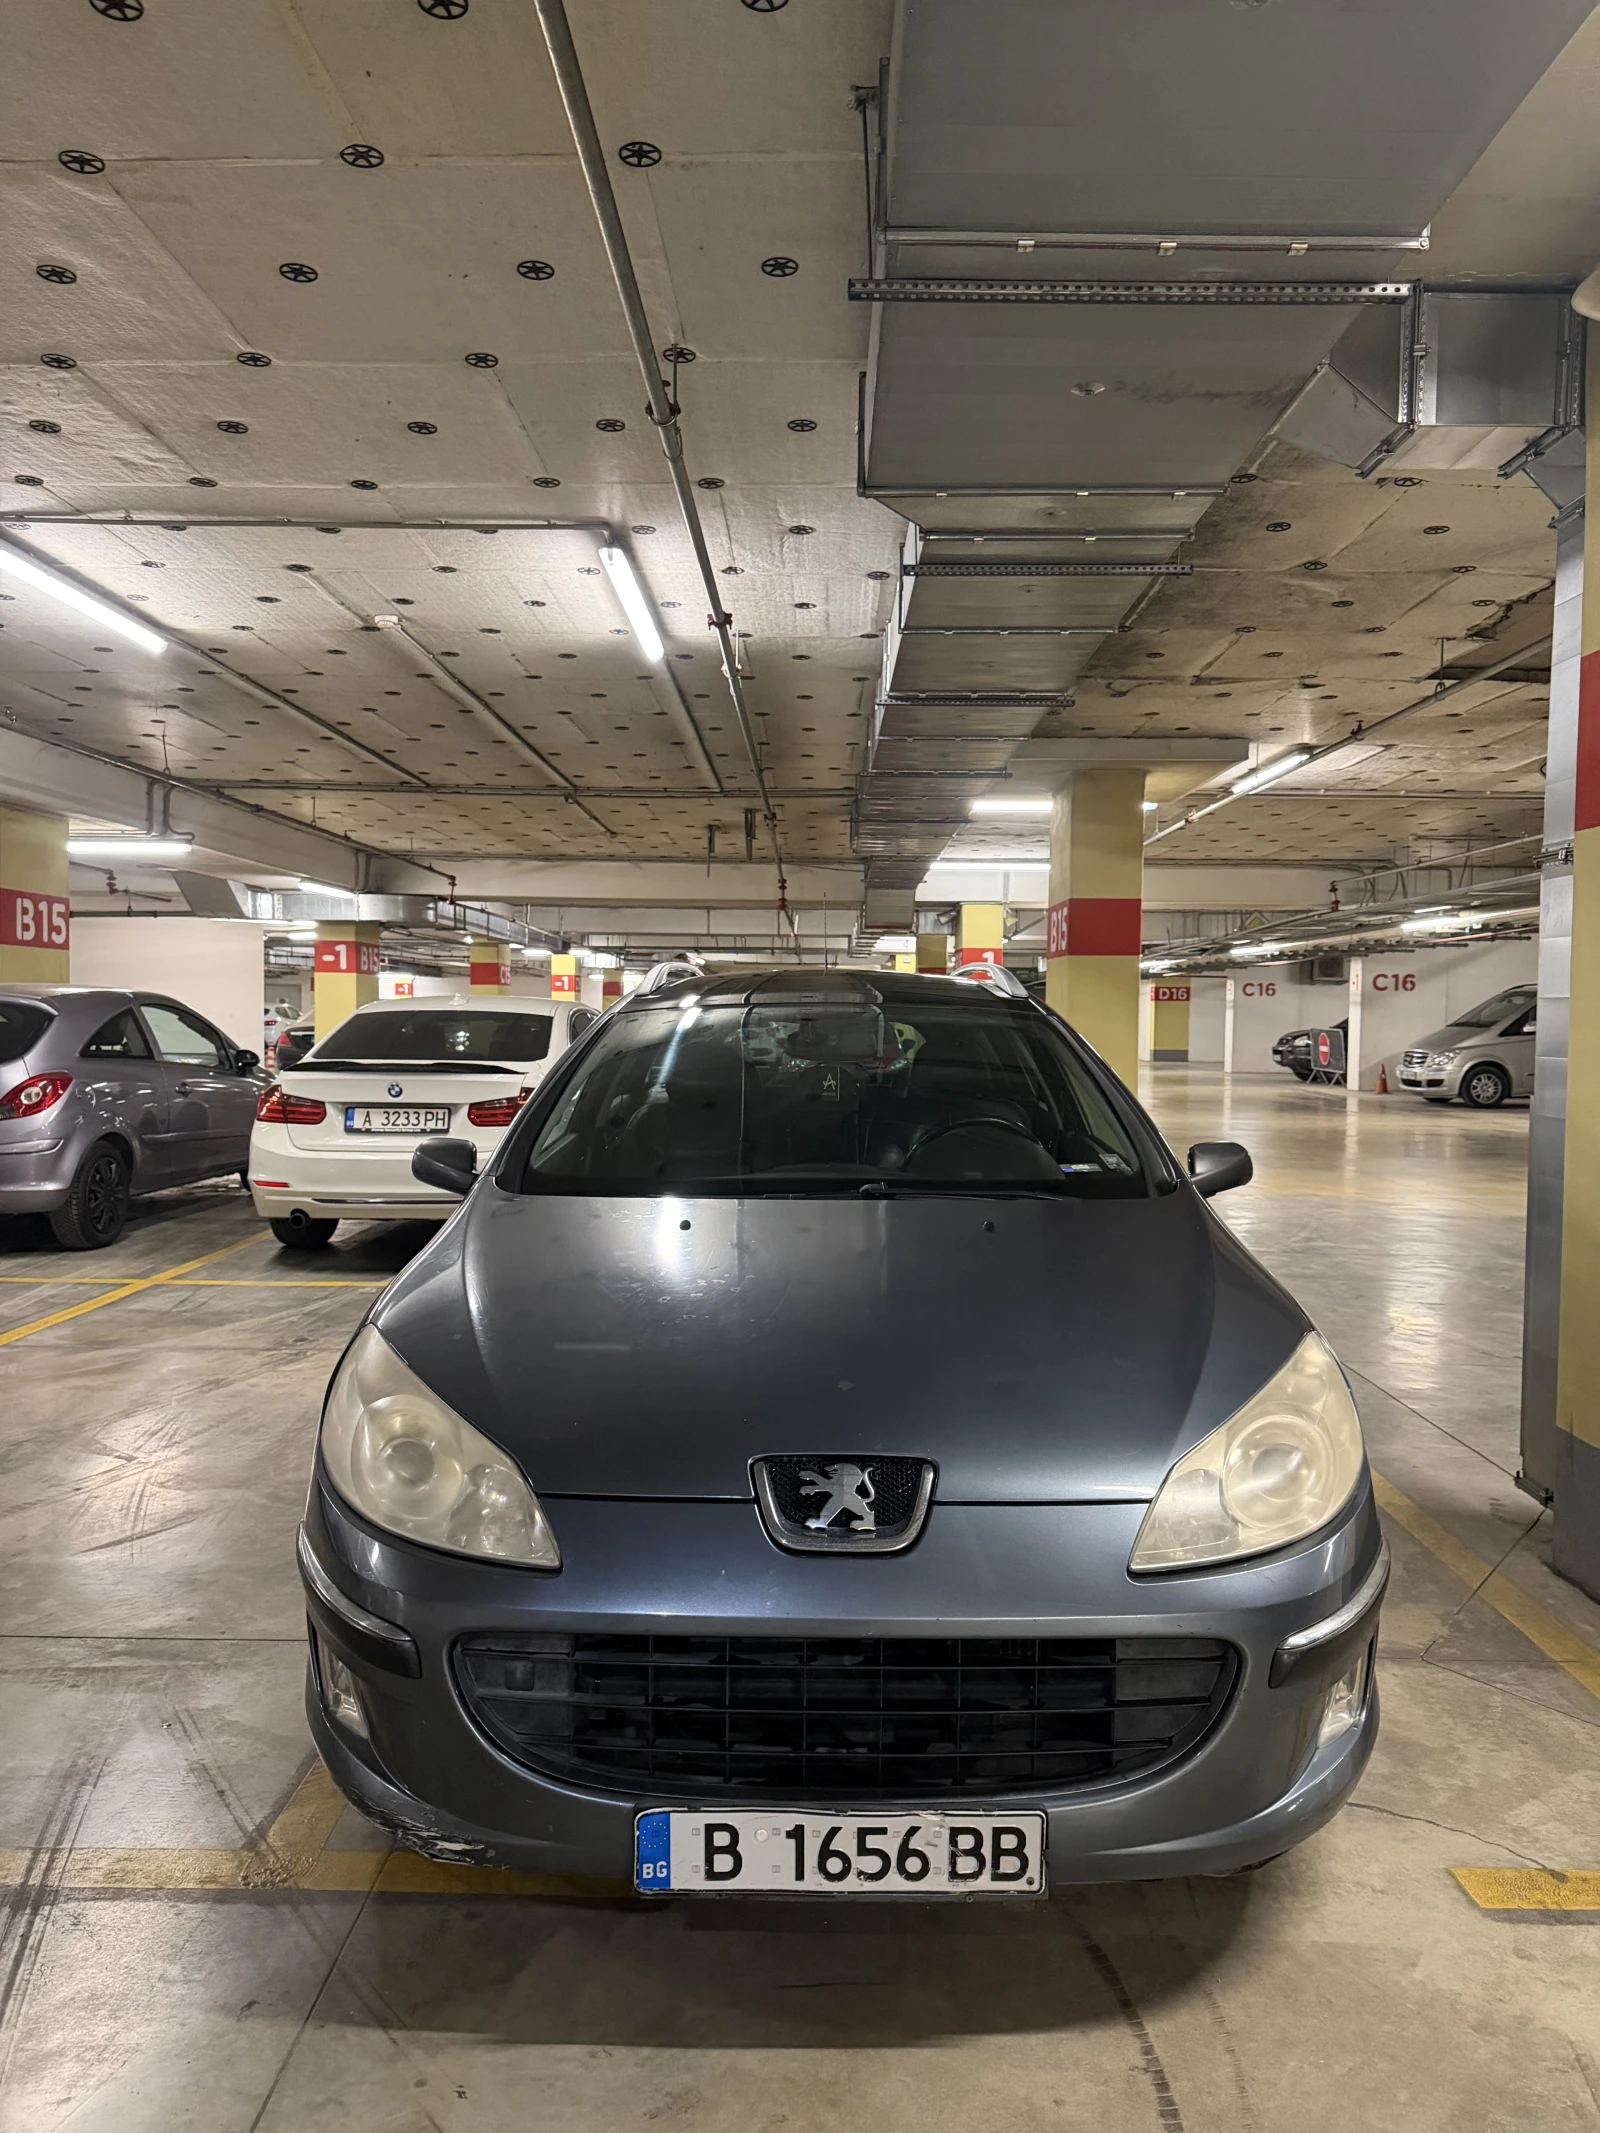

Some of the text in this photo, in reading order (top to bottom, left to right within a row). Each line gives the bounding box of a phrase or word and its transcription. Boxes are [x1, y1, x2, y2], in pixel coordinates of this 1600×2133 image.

[16, 897, 67, 945] B15
[1050, 906, 1068, 953] B15
[322, 943, 348, 971] -1
[361, 945, 379, 973] B15
[397, 983, 409, 995] -1
[554, 975, 569, 991] -1
[1242, 982, 1277, 997] C16
[1372, 973, 1417, 992] C16
[1158, 988, 1188, 1000] D16
[363, 1110, 372, 1127] A
[381, 1110, 421, 1127] 3233
[424, 1111, 446, 1127] PH
[642, 1822, 1030, 1883] BG B 1656 BB
